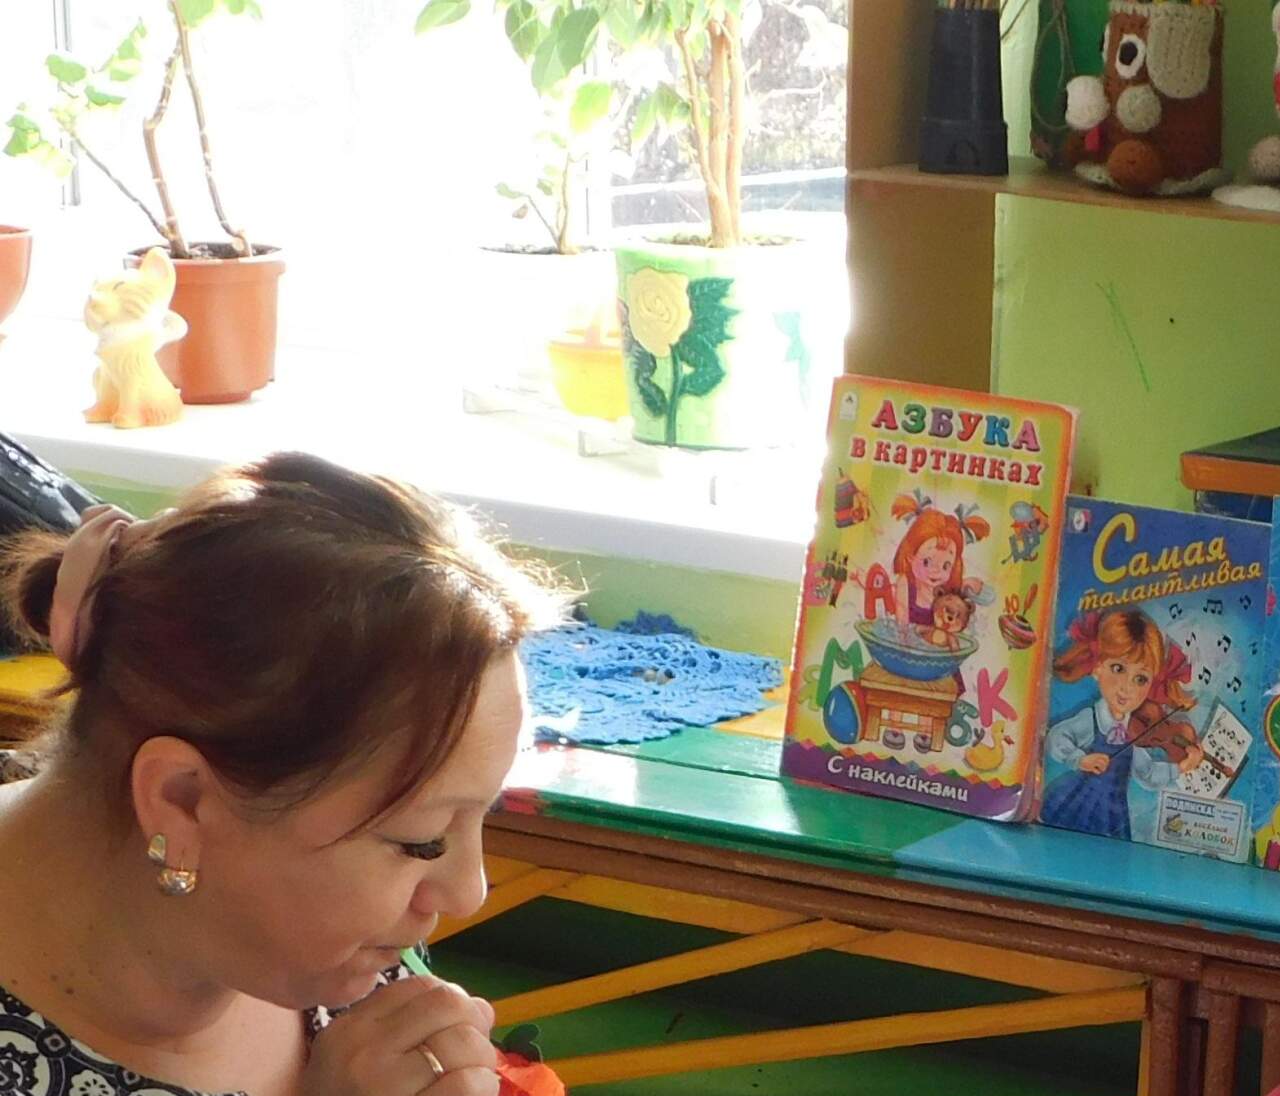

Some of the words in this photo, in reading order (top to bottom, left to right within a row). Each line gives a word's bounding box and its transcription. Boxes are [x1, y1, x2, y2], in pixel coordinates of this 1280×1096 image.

[871, 400, 1041, 452] АЗБУКА
[850, 437, 866, 458] в
[873, 440, 1042, 486] картинках
[1092, 512, 1228, 584] Самая
[1077, 560, 1263, 611] талантливая
[847, 763, 969, 802] наклейками
